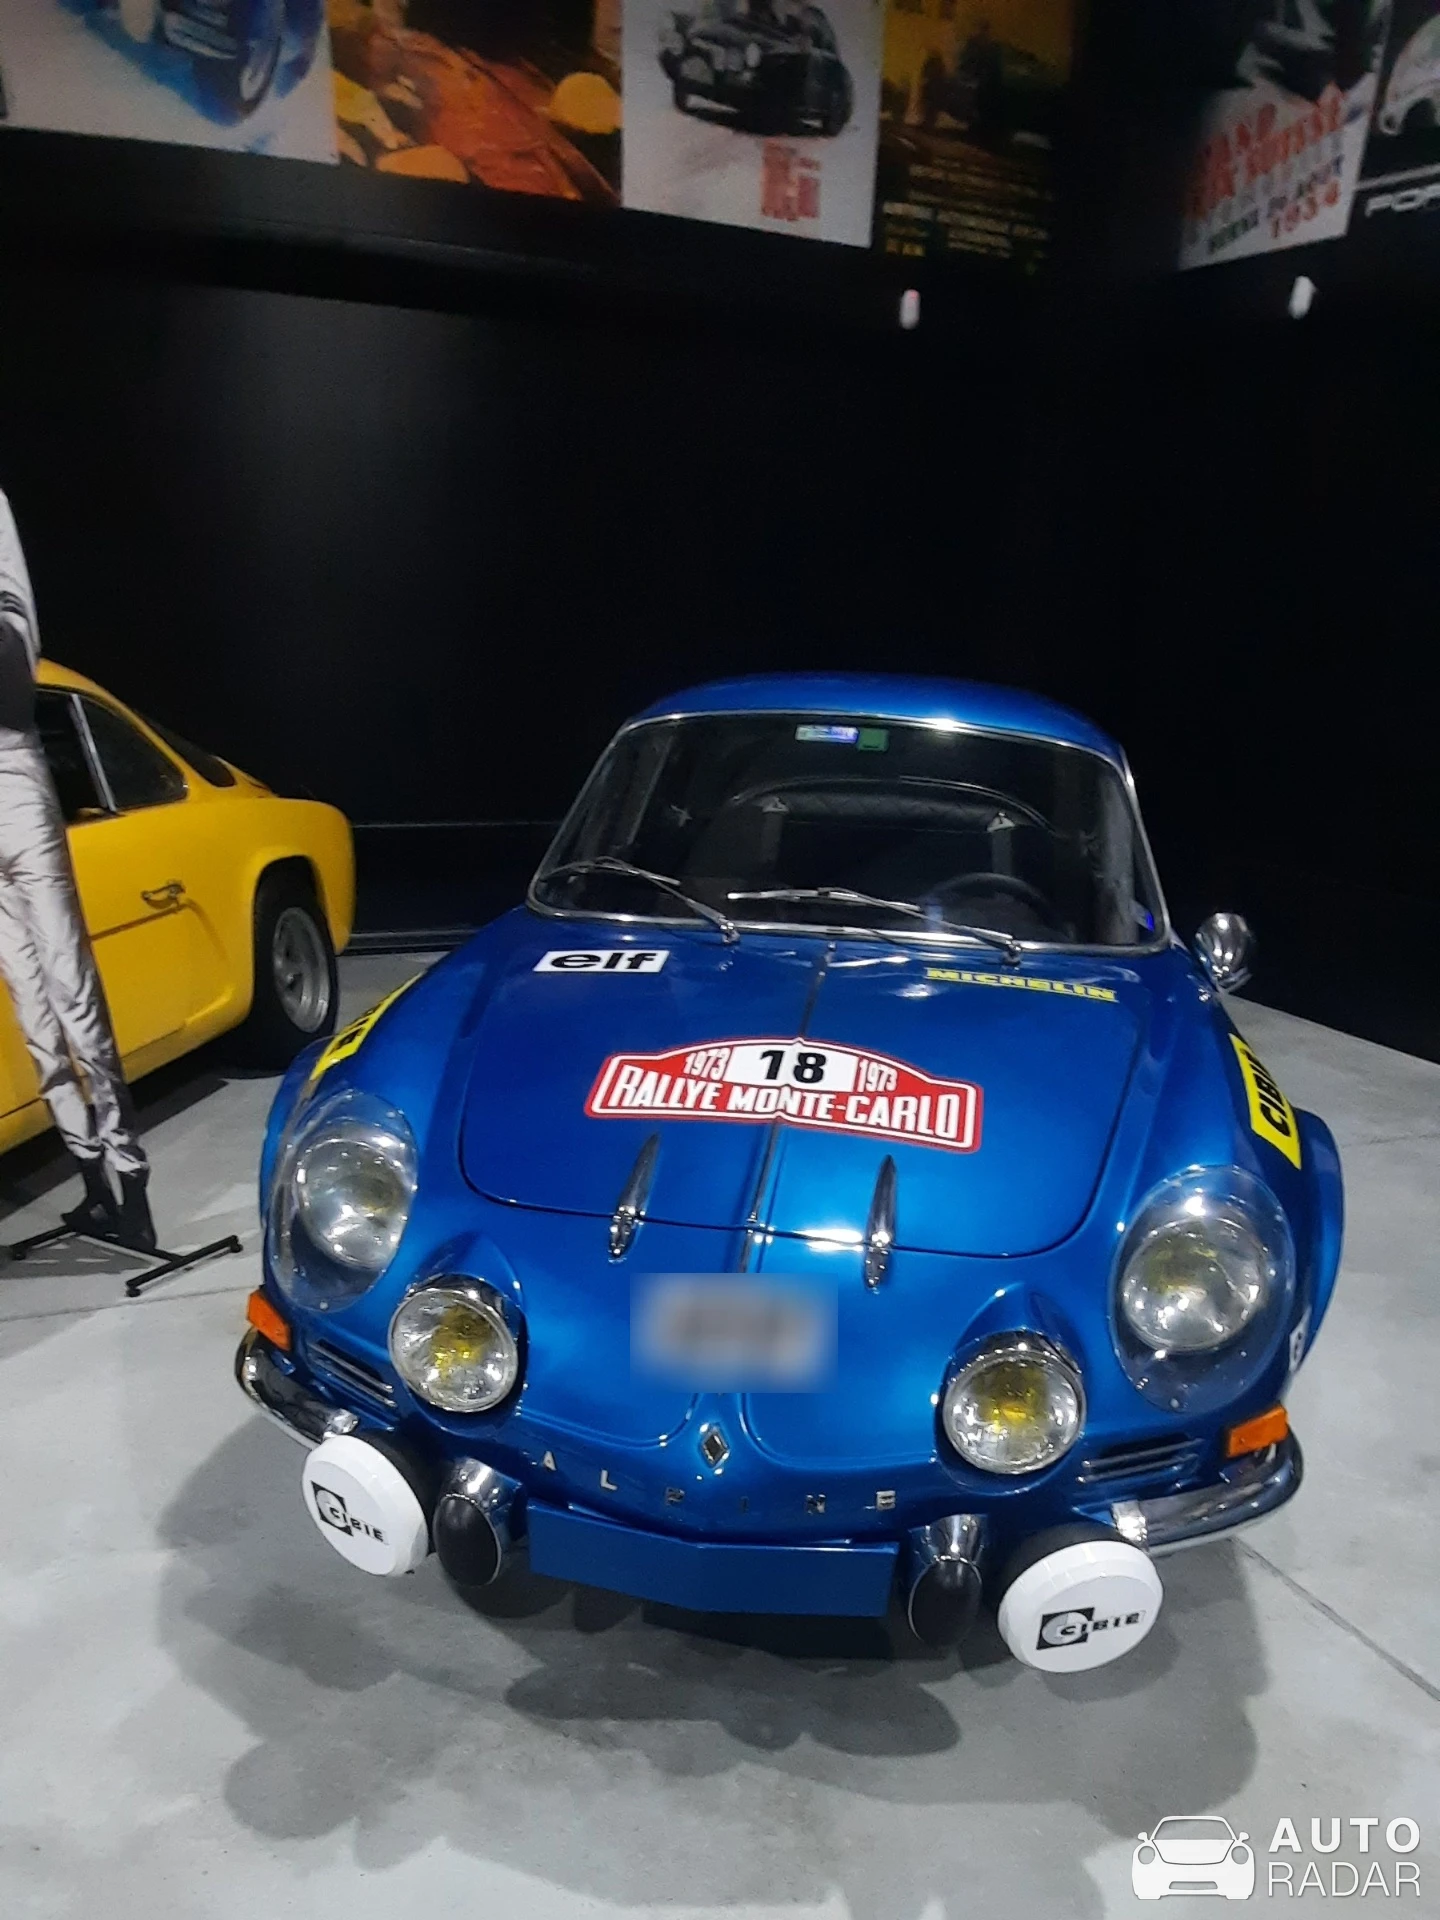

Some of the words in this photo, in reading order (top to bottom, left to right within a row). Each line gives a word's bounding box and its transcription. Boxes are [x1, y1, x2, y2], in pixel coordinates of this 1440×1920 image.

[550, 952, 657, 970] elf
[927, 969, 1116, 1001] MICHELIN
[683, 1047, 731, 1081] 1973
[759, 1050, 827, 1084] 18
[858, 1058, 898, 1093] 1973
[607, 1064, 724, 1110] RALLYE
[726, 1085, 961, 1140] MONTE-CARLO
